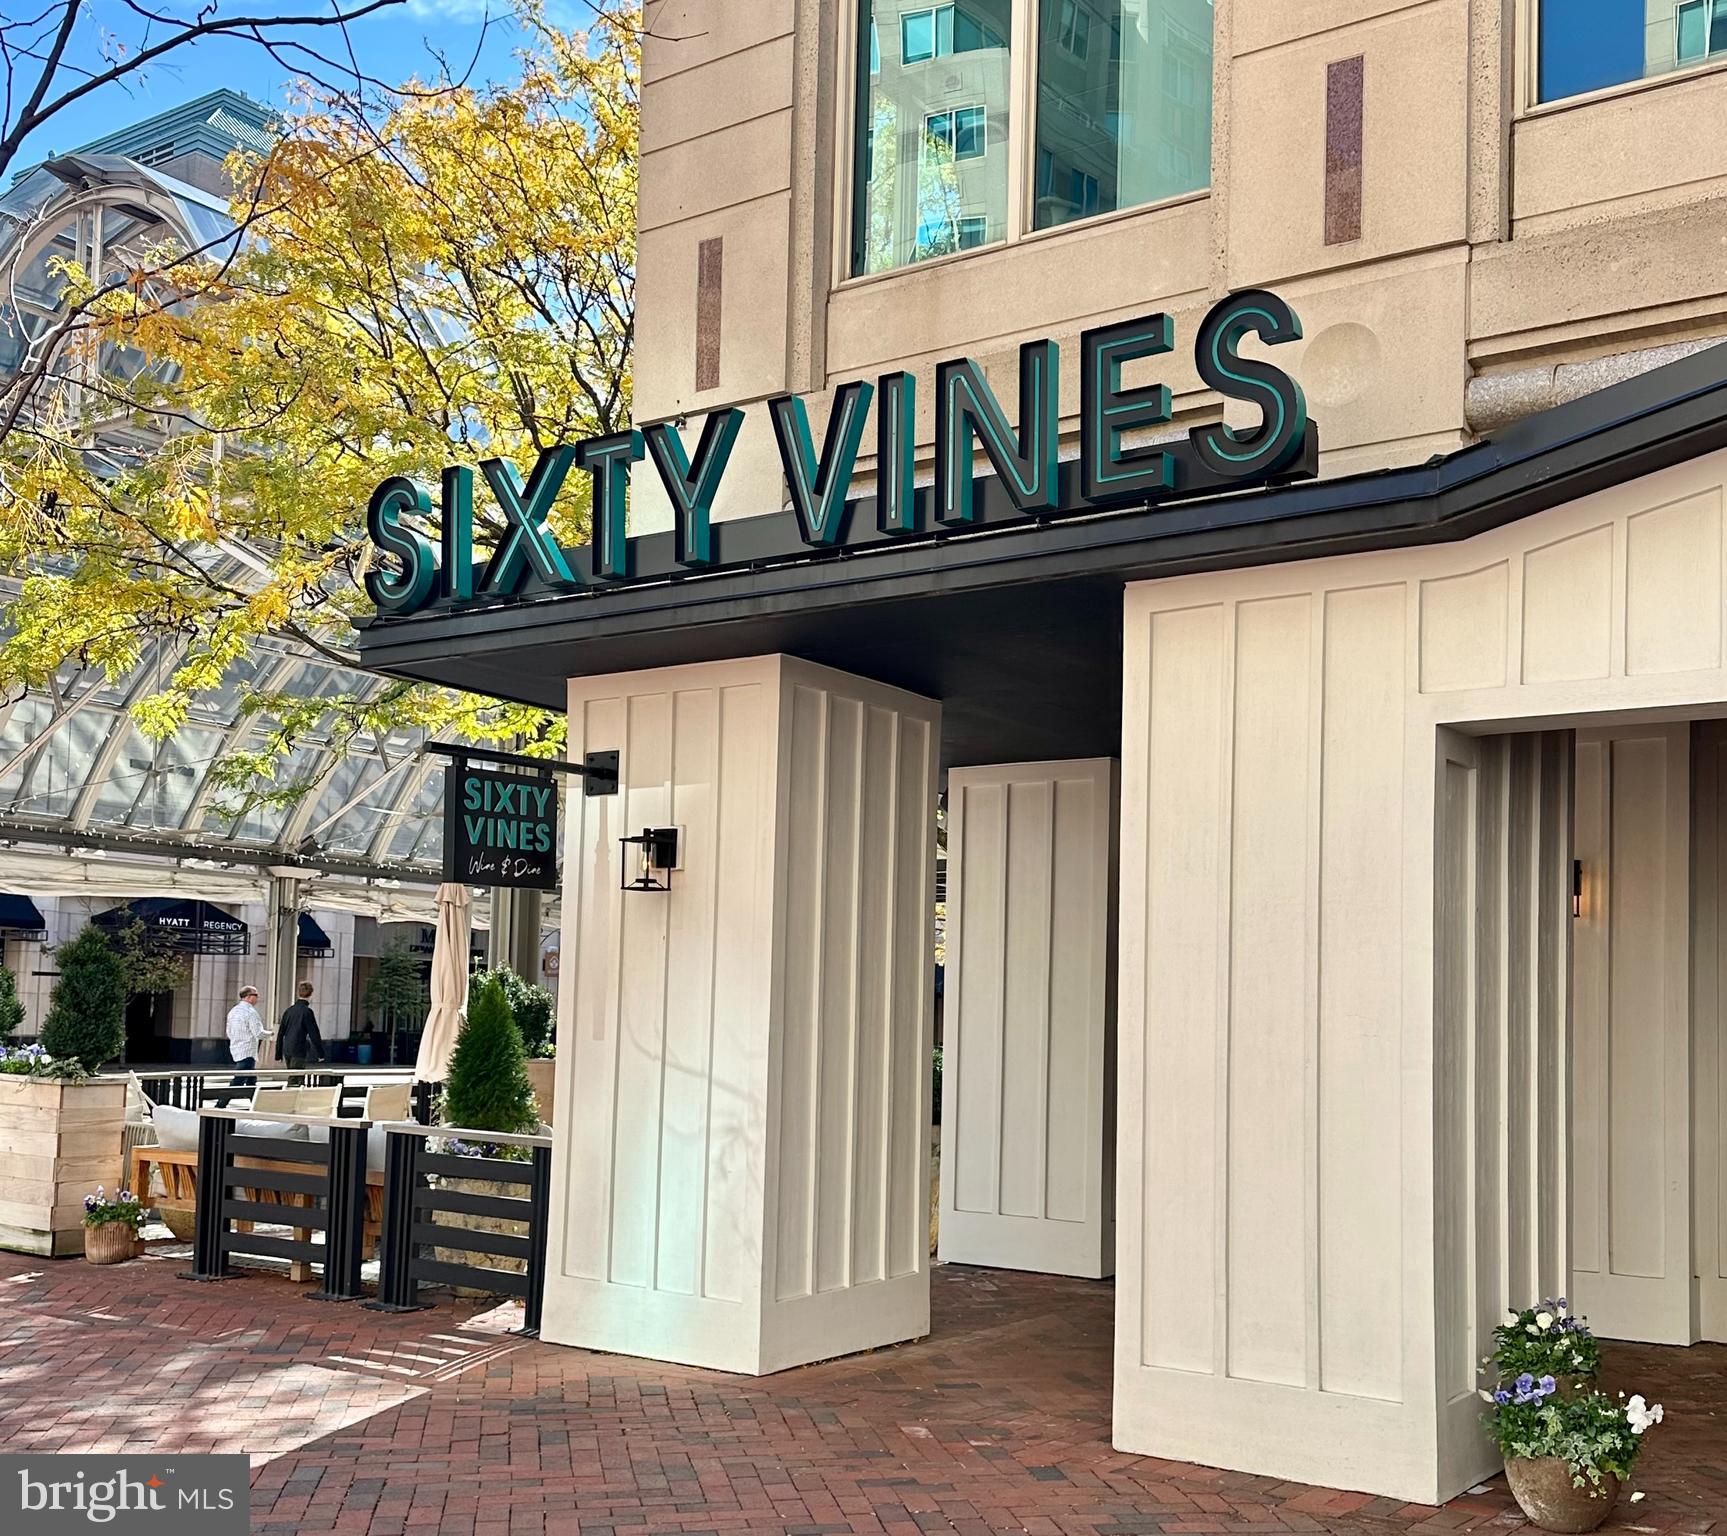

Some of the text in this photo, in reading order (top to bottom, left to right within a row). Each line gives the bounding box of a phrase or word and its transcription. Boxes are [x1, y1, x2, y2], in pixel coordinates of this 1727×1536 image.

[365, 289, 1310, 616] SIXTY VINES
[463, 777, 551, 818] SIXTY
[463, 814, 551, 853] VINES
[468, 851, 542, 878] Wine & Dine
[158, 917, 243, 932] HYATT REGENCY
